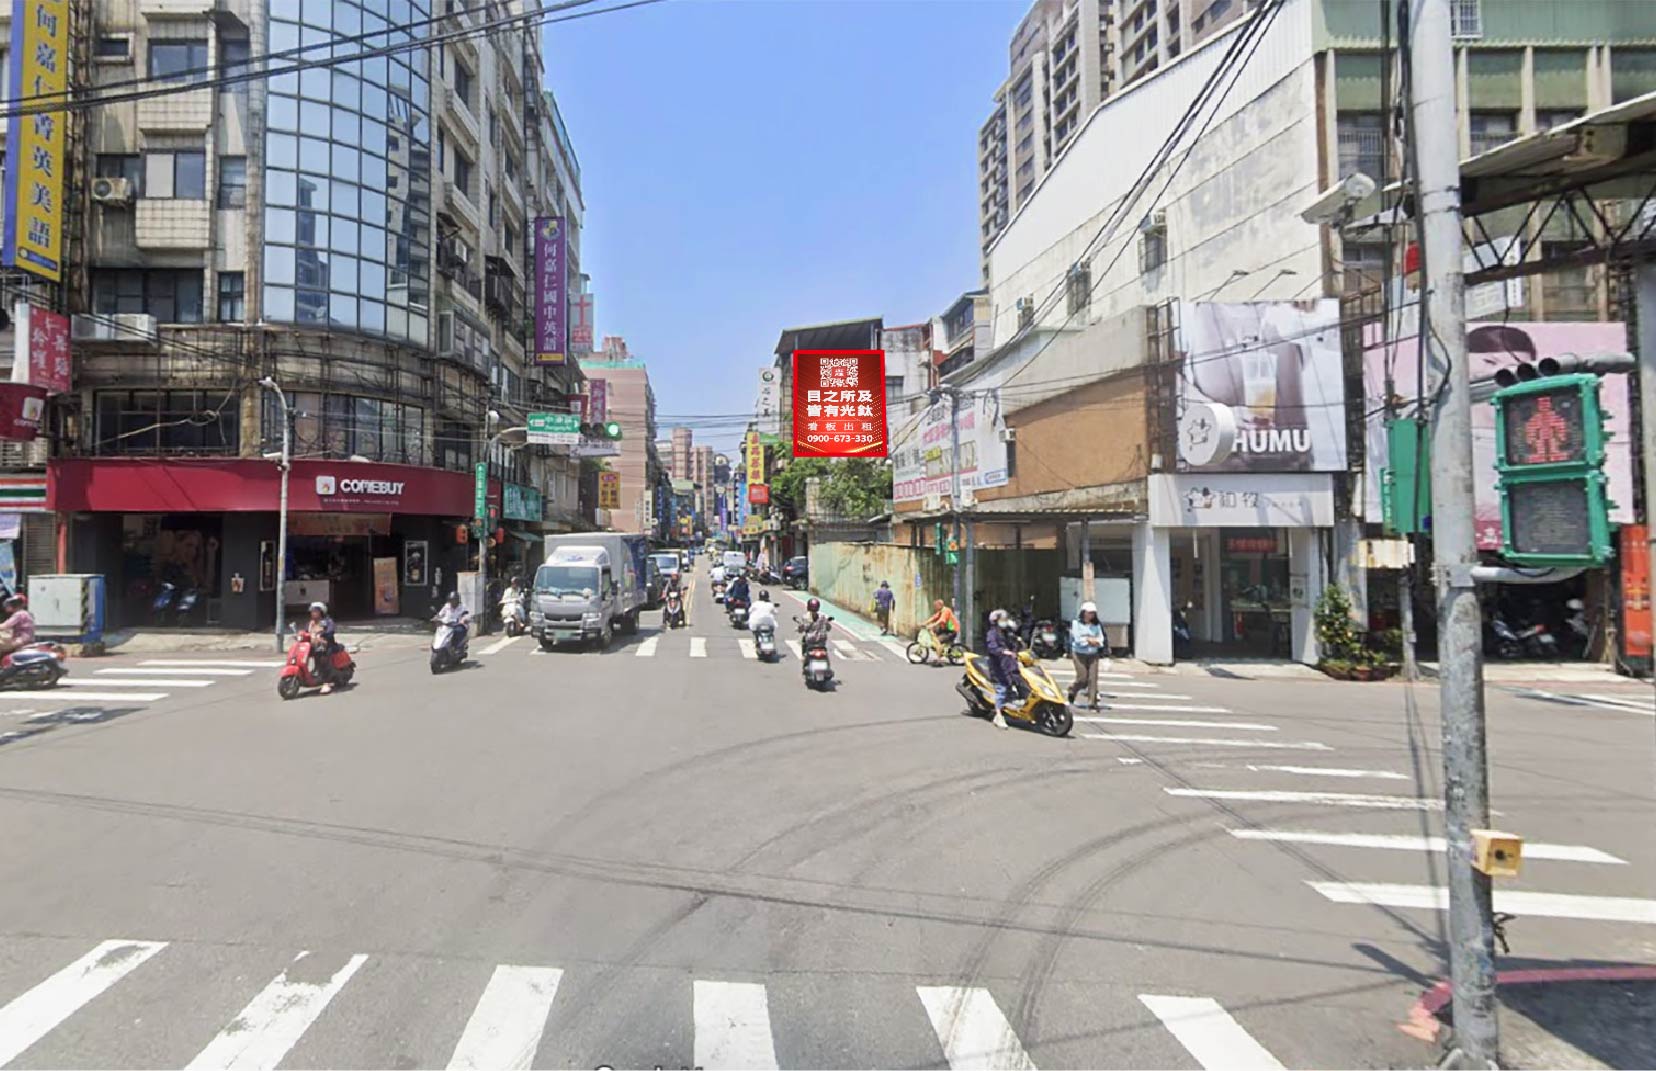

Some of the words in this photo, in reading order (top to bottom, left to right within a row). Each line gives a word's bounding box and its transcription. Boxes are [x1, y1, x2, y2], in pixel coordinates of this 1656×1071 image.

[807, 390, 873, 403] 目之所及
[806, 405, 874, 417] 皆有光鈦
[807, 422, 872, 431] 看板出租
[807, 434, 873, 443] 0900-673-330
[340, 479, 404, 495] COMEBUY
